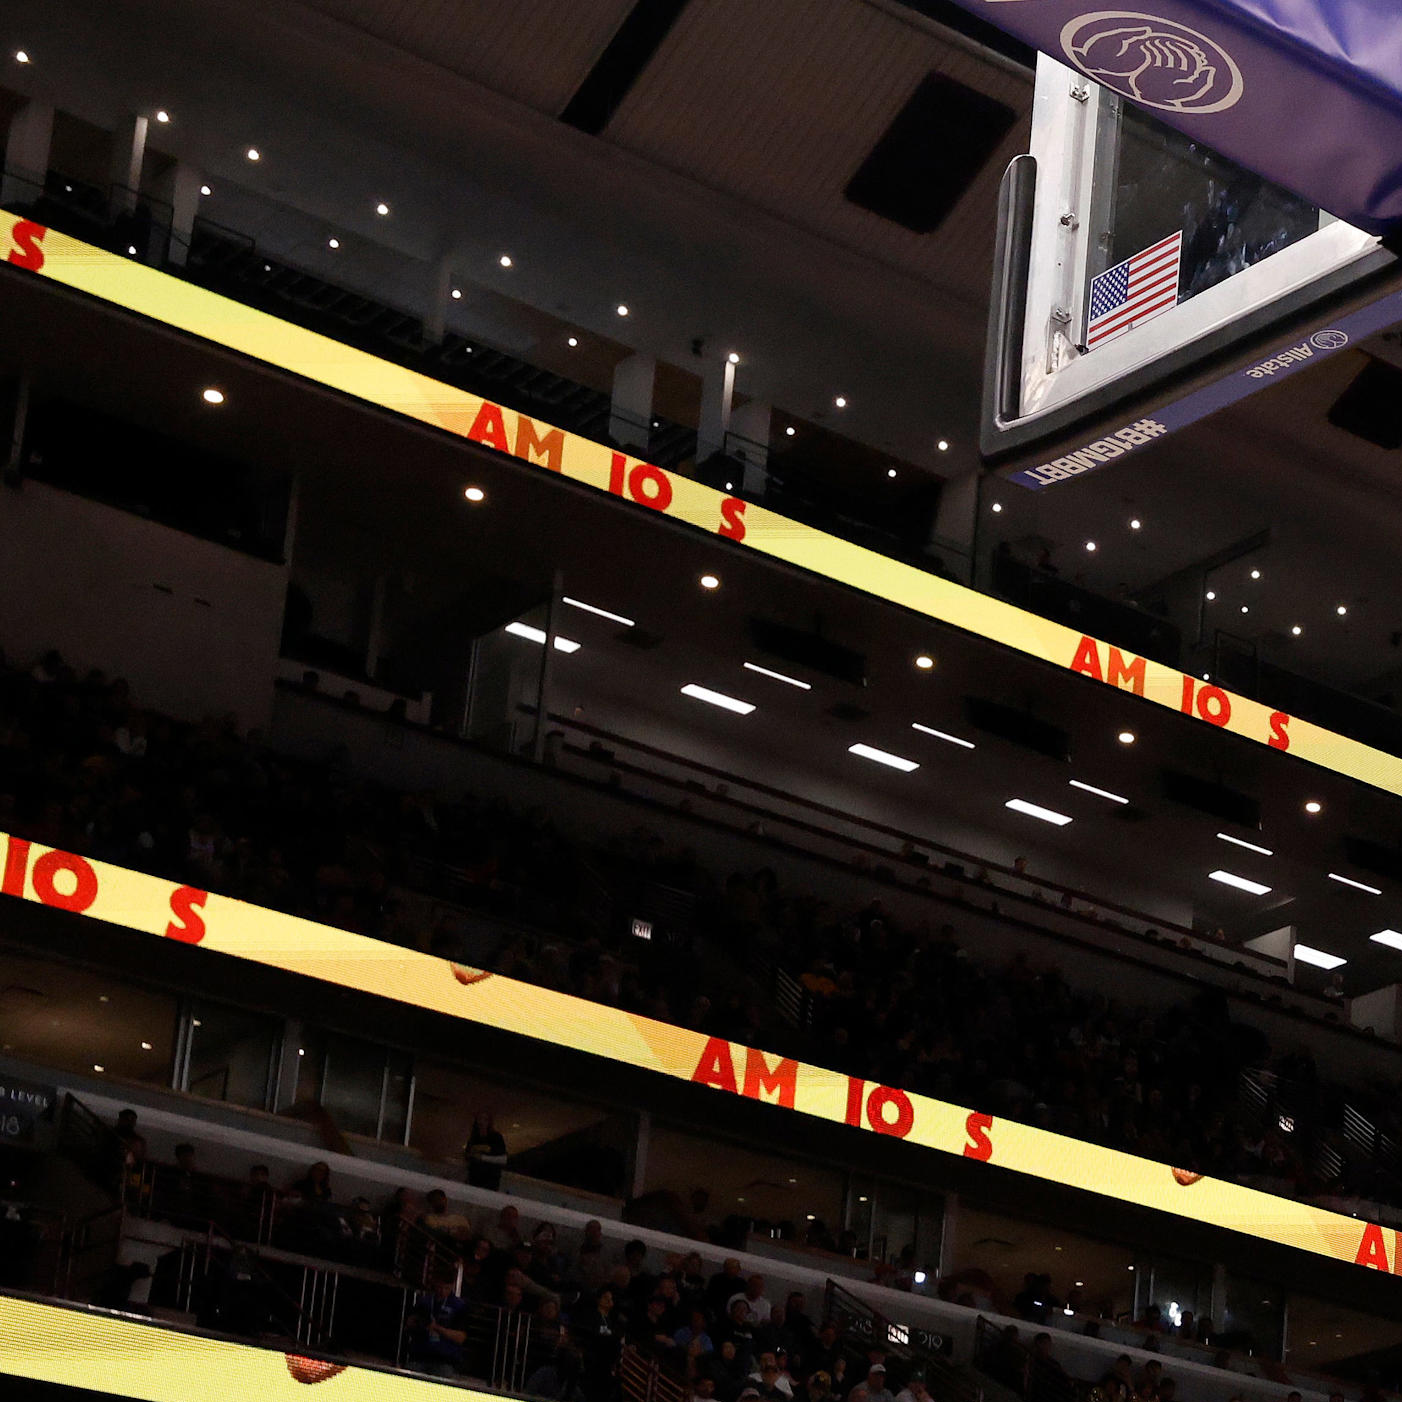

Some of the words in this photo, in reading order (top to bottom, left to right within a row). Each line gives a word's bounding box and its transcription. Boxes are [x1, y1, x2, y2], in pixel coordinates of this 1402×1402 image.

[9, 220, 48, 273] S
[1246, 342, 1312, 379] Allstate
[467, 402, 566, 473] AM
[609, 452, 673, 513] IO
[719, 498, 747, 543] S
[1024, 418, 1167, 486] #B1GMBBT
[1070, 637, 1147, 697] AM
[1181, 676, 1232, 728] IO
[1269, 713, 1291, 752] S
[2, 838, 99, 915] IO
[165, 886, 209, 946] S
[692, 1038, 799, 1109] AM
[846, 1078, 915, 1139] IO
[964, 1113, 993, 1163] S
